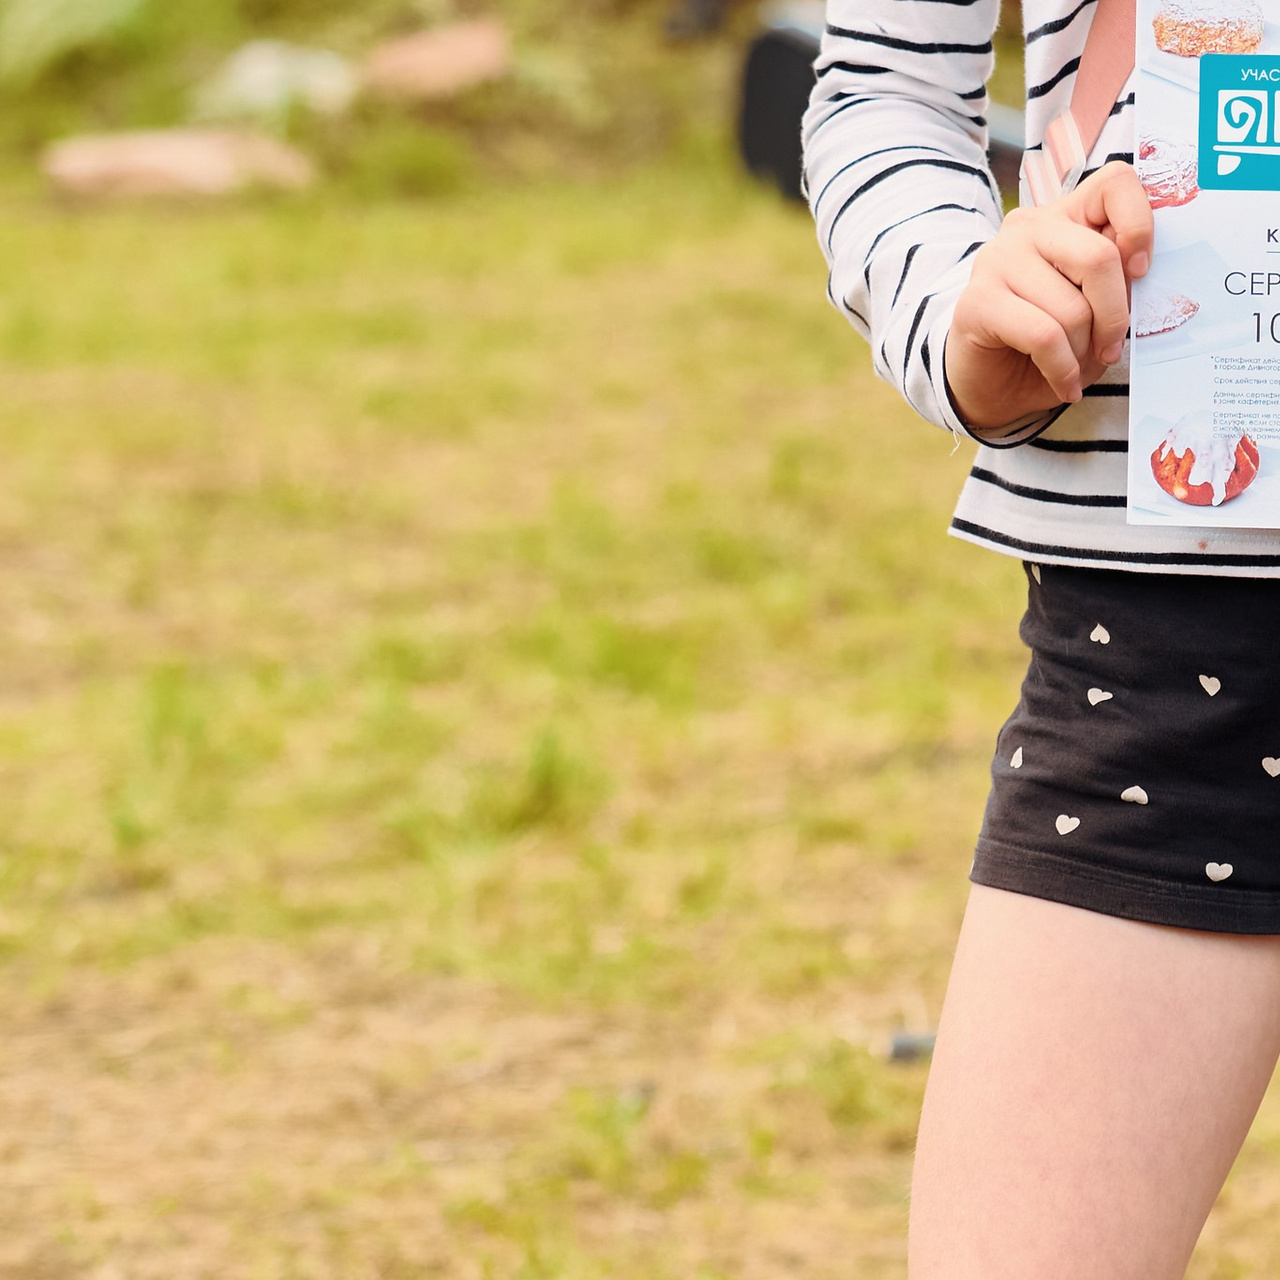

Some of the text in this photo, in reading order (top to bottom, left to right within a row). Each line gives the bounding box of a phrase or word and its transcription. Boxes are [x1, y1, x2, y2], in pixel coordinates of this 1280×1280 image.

[1213, 377, 1233, 385] Срок
[1234, 377, 1268, 385] действия
[1213, 391, 1244, 399] Данным
[1213, 411, 1260, 419] Сертификат
